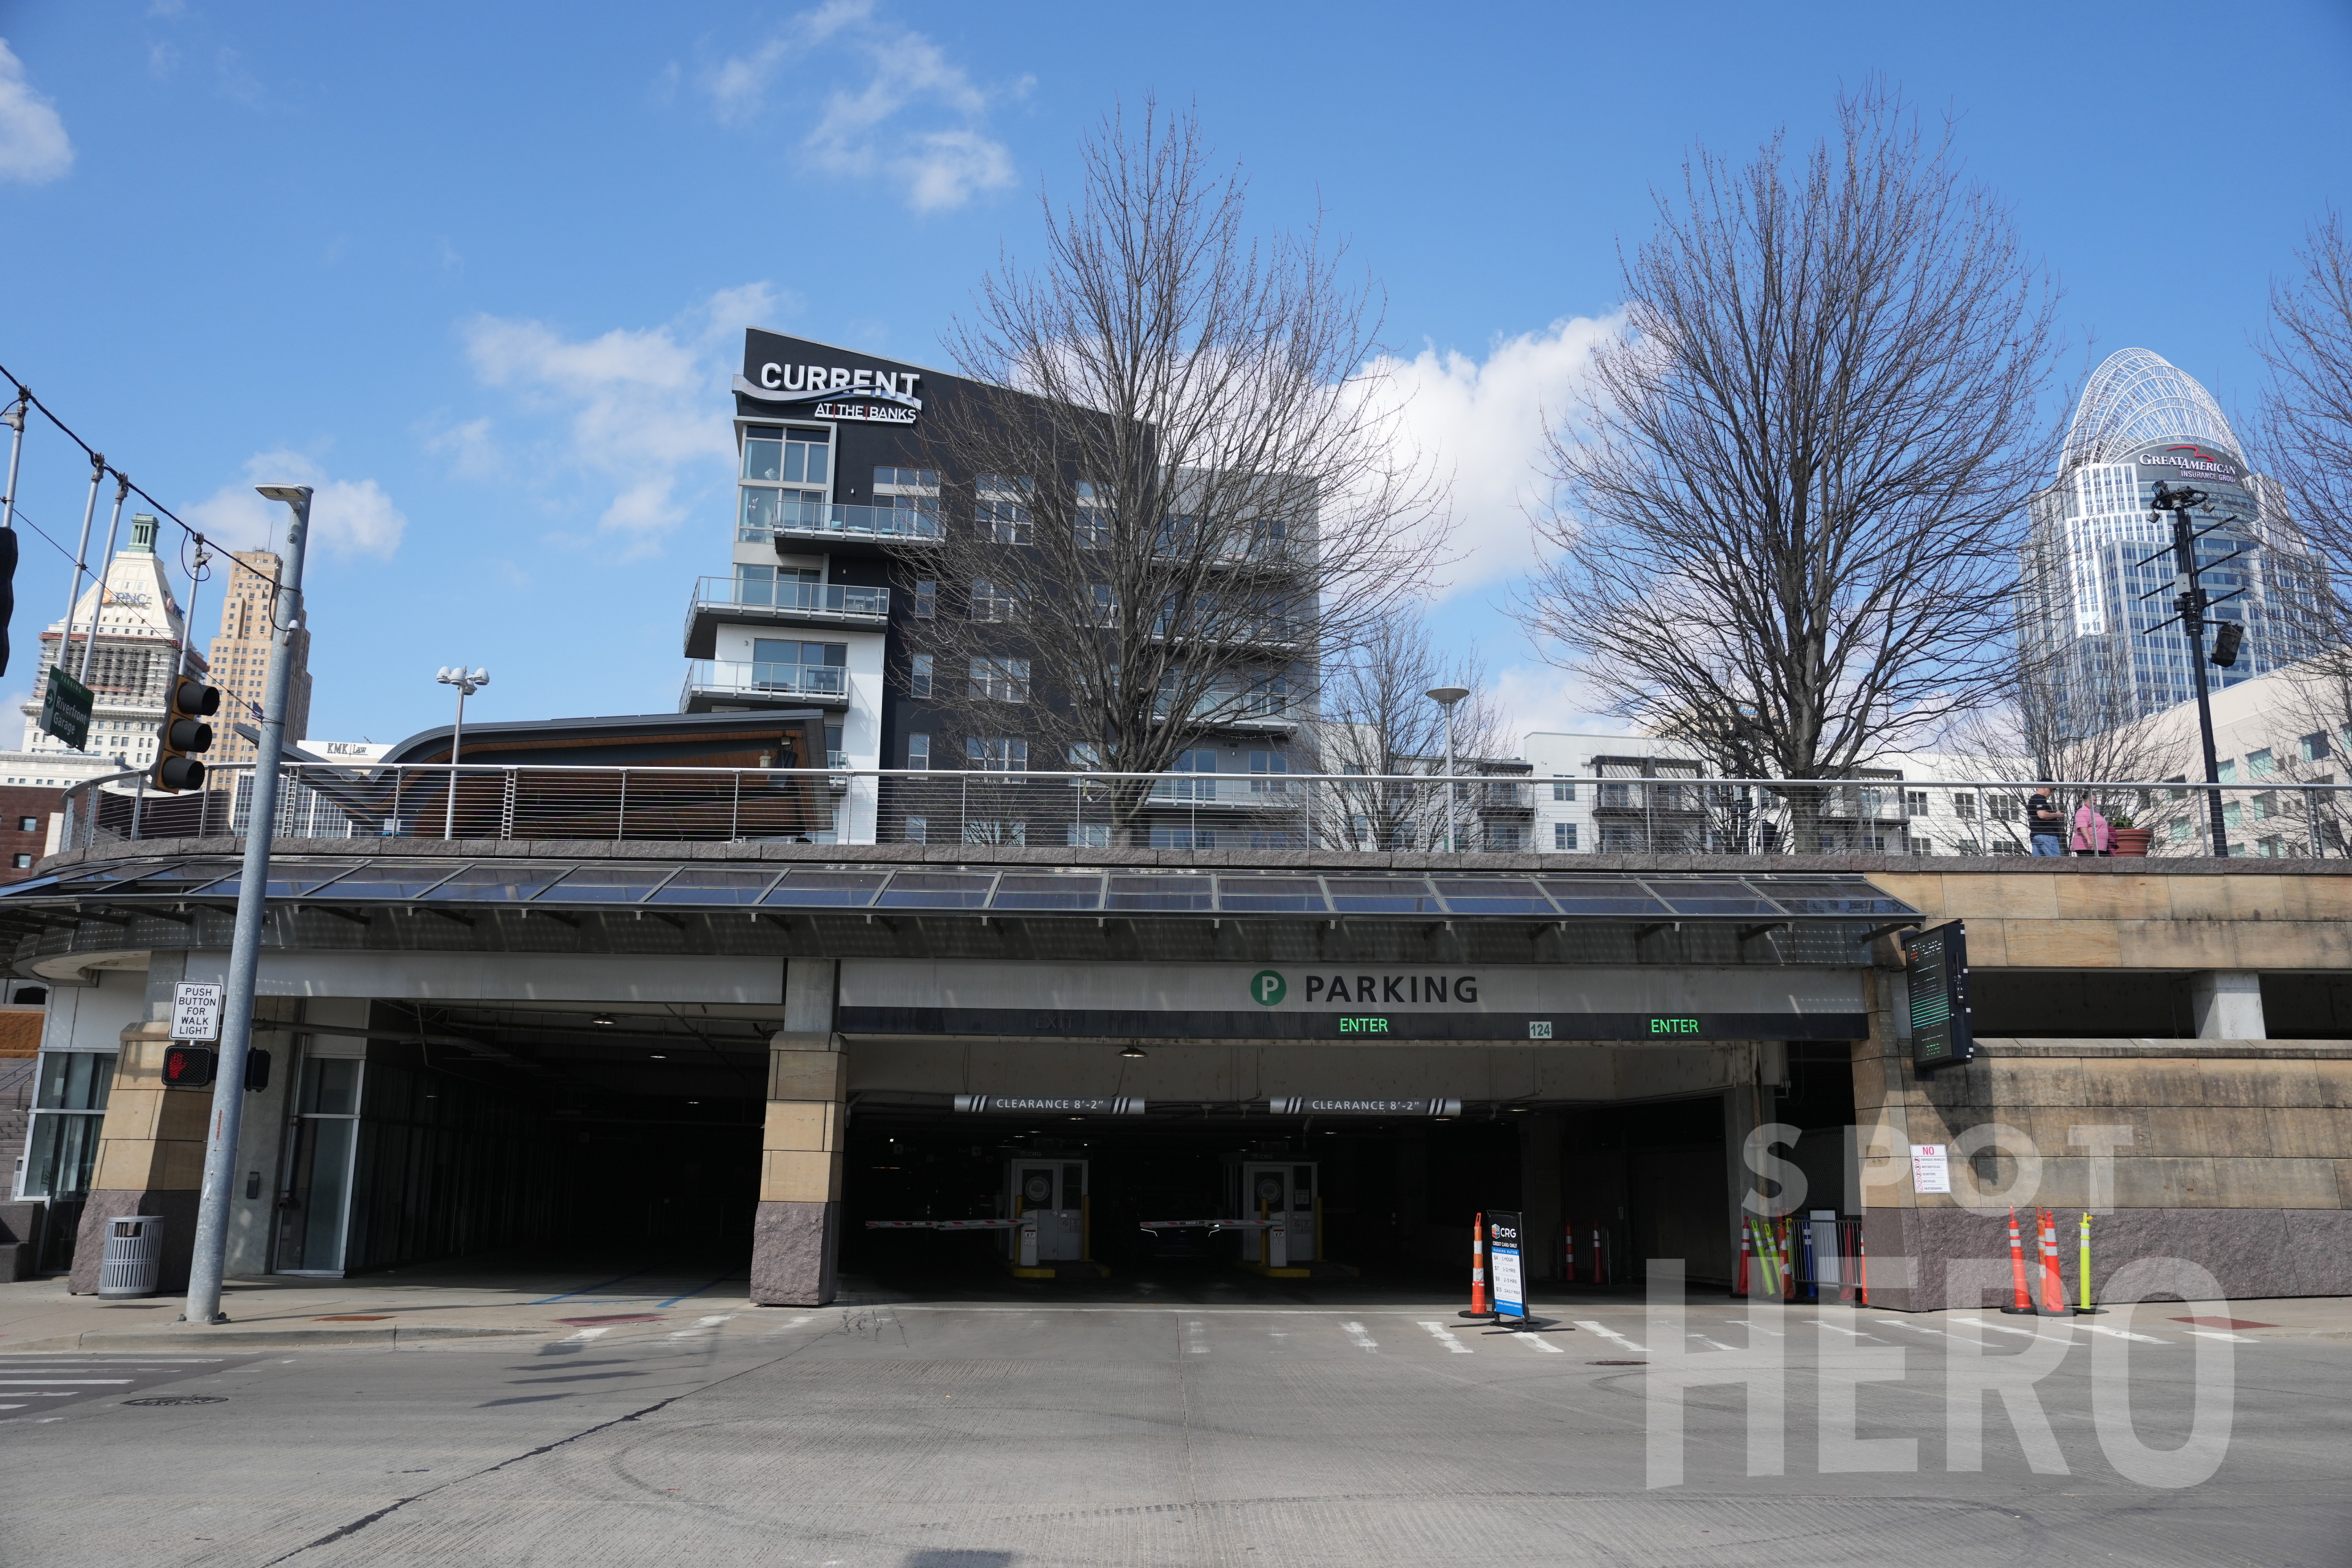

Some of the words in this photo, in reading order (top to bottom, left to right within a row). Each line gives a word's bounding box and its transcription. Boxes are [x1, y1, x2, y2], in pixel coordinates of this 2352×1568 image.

[761, 363, 920, 398] CURRENT
[815, 402, 832, 415] AT
[837, 404, 864, 417] THE
[869, 406, 916, 421] BANKS
[2180, 470, 2217, 480] INSURANCE
[115, 592, 147, 605] PNC
[173, 603, 185, 621] PNC
[61, 675, 82, 693] PARKING
[56, 695, 87, 725] Riverfront
[53, 712, 75, 736] Garage
[327, 743, 349, 754] KMK
[353, 744, 366, 754] Law
[185, 987, 212, 997] PUSH
[1306, 975, 1477, 1003] PARKING
[178, 997, 216, 1006] BUTTON
[186, 1007, 206, 1016] FOR
[181, 1016, 209, 1025] WALK
[1036, 1016, 1076, 1028] EXIT
[1340, 1018, 1389, 1032] ENTER
[1651, 1019, 1698, 1033] ENTER
[179, 1026, 208, 1035] LIGHT
[1531, 1023, 1551, 1036] 124
[997, 1099, 1069, 1109] CLEARANCE
[1312, 1100, 1385, 1110] CLEARANCE
[1922, 1147, 1934, 1155] NO
[1501, 1227, 1517, 1238] CRG
